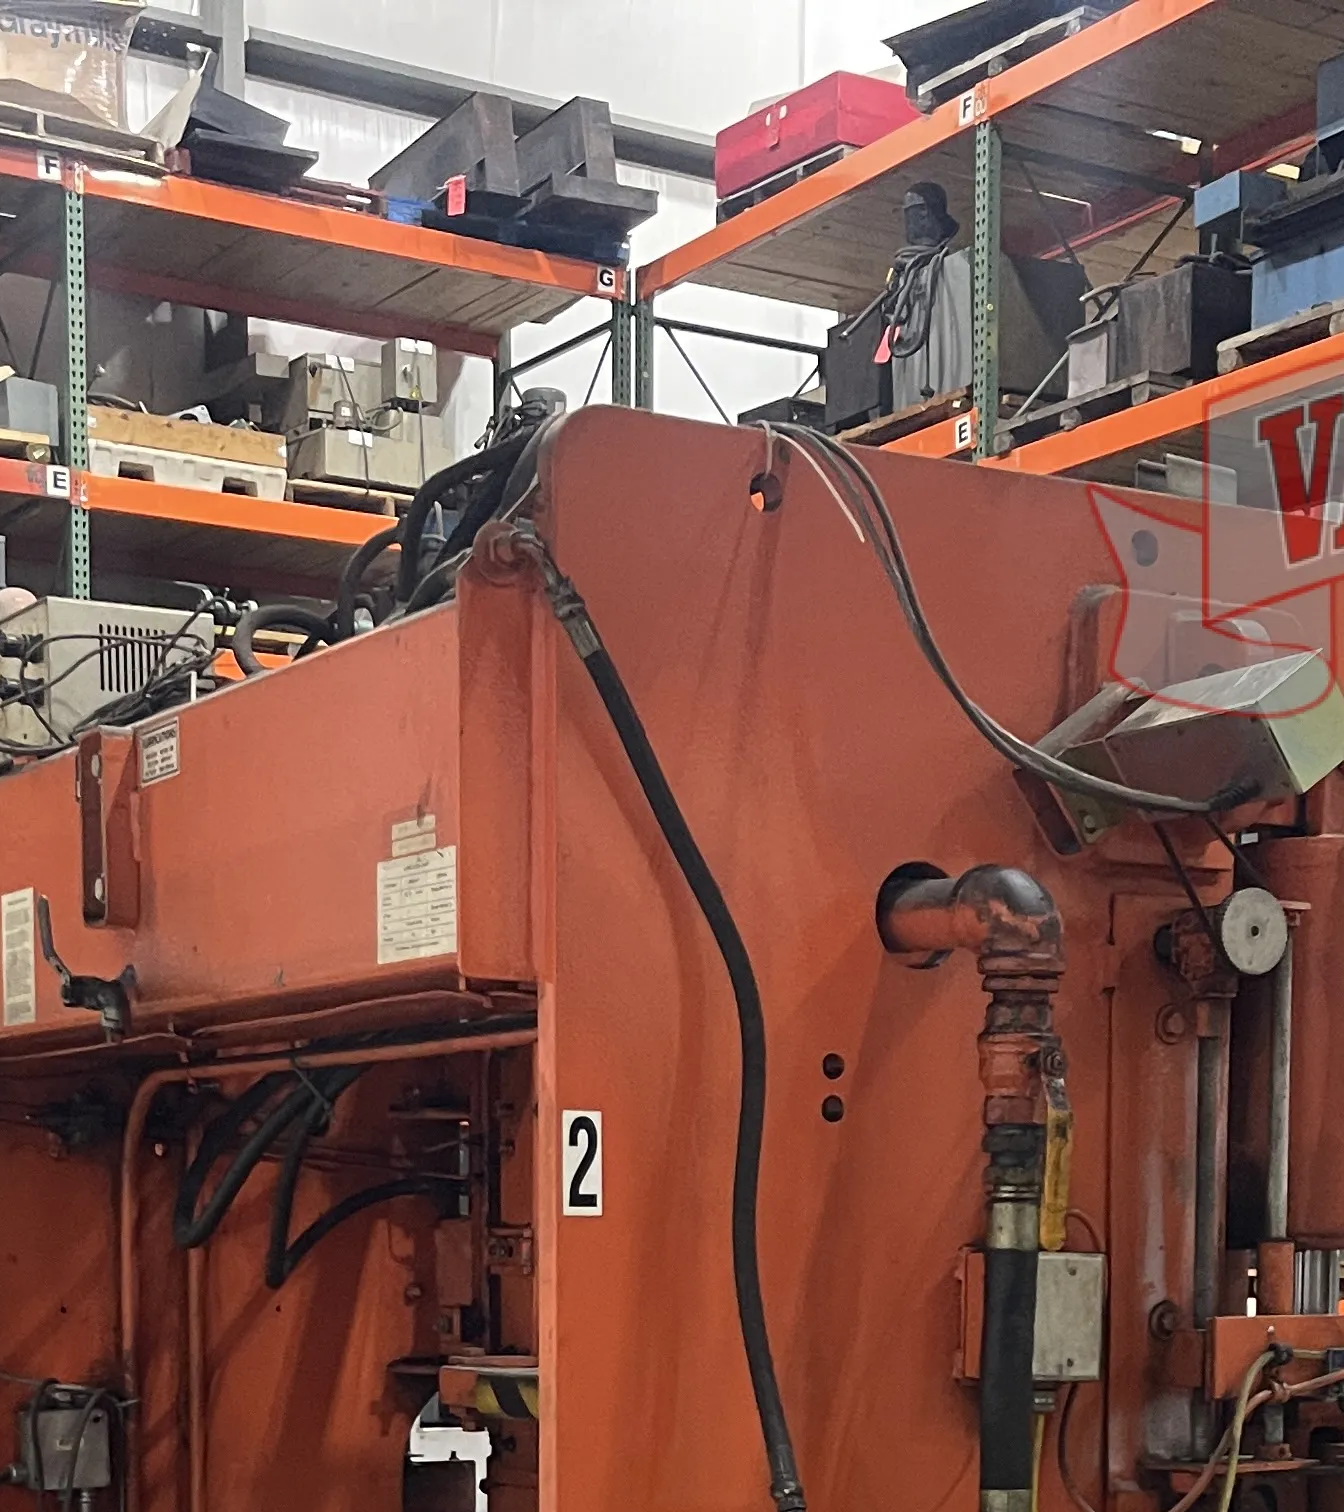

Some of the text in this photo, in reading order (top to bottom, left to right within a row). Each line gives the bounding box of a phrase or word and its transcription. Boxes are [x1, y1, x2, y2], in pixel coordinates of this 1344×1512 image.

[962, 95, 973, 119] F
[44, 156, 60, 175] F
[599, 269, 614, 287] G
[958, 421, 969, 443] E
[53, 471, 67, 491] E
[568, 1115, 599, 1208] 2
